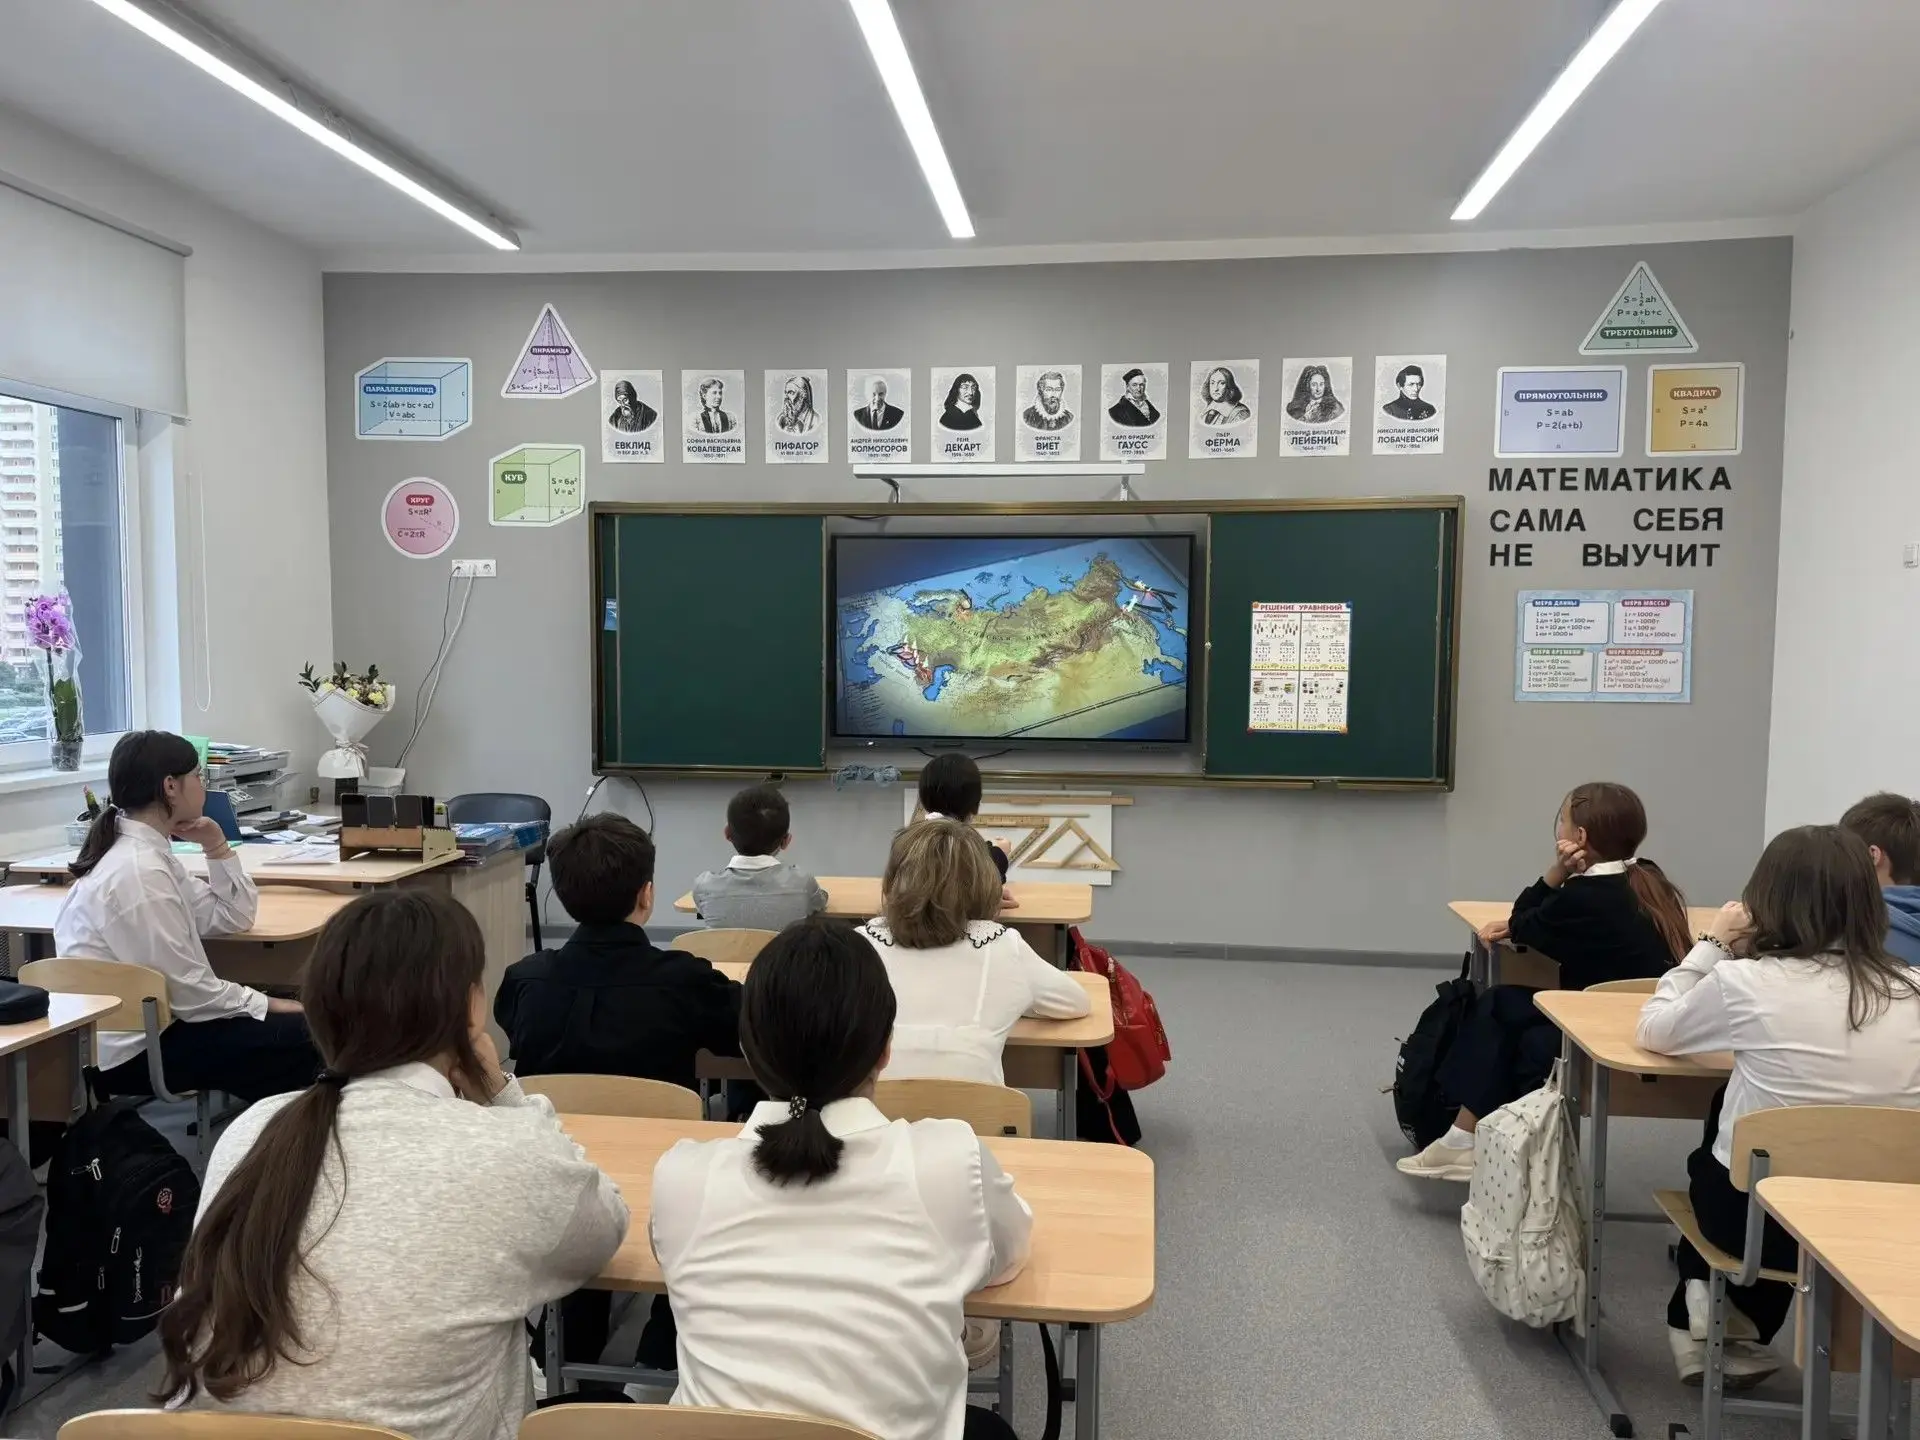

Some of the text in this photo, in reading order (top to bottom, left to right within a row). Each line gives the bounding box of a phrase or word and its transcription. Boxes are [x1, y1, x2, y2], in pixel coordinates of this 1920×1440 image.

[1205, 438, 1240, 447] ФЕРМА
[1378, 434, 1438, 443] ЛОБАЧЕВСКИЙ
[615, 442, 651, 450] ЕВКЛИД
[775, 442, 819, 450] ПИФАГОР
[945, 444, 981, 452] ДЕКАРТ
[1036, 442, 1059, 450] ВИЕТ
[1118, 441, 1148, 449] ГАУСС
[1489, 466, 1732, 491] МАТЕМАТИКА
[1490, 507, 1723, 532] САМА СЕБЯ
[1490, 544, 1720, 567] НЕ ВЫУЧИТ
